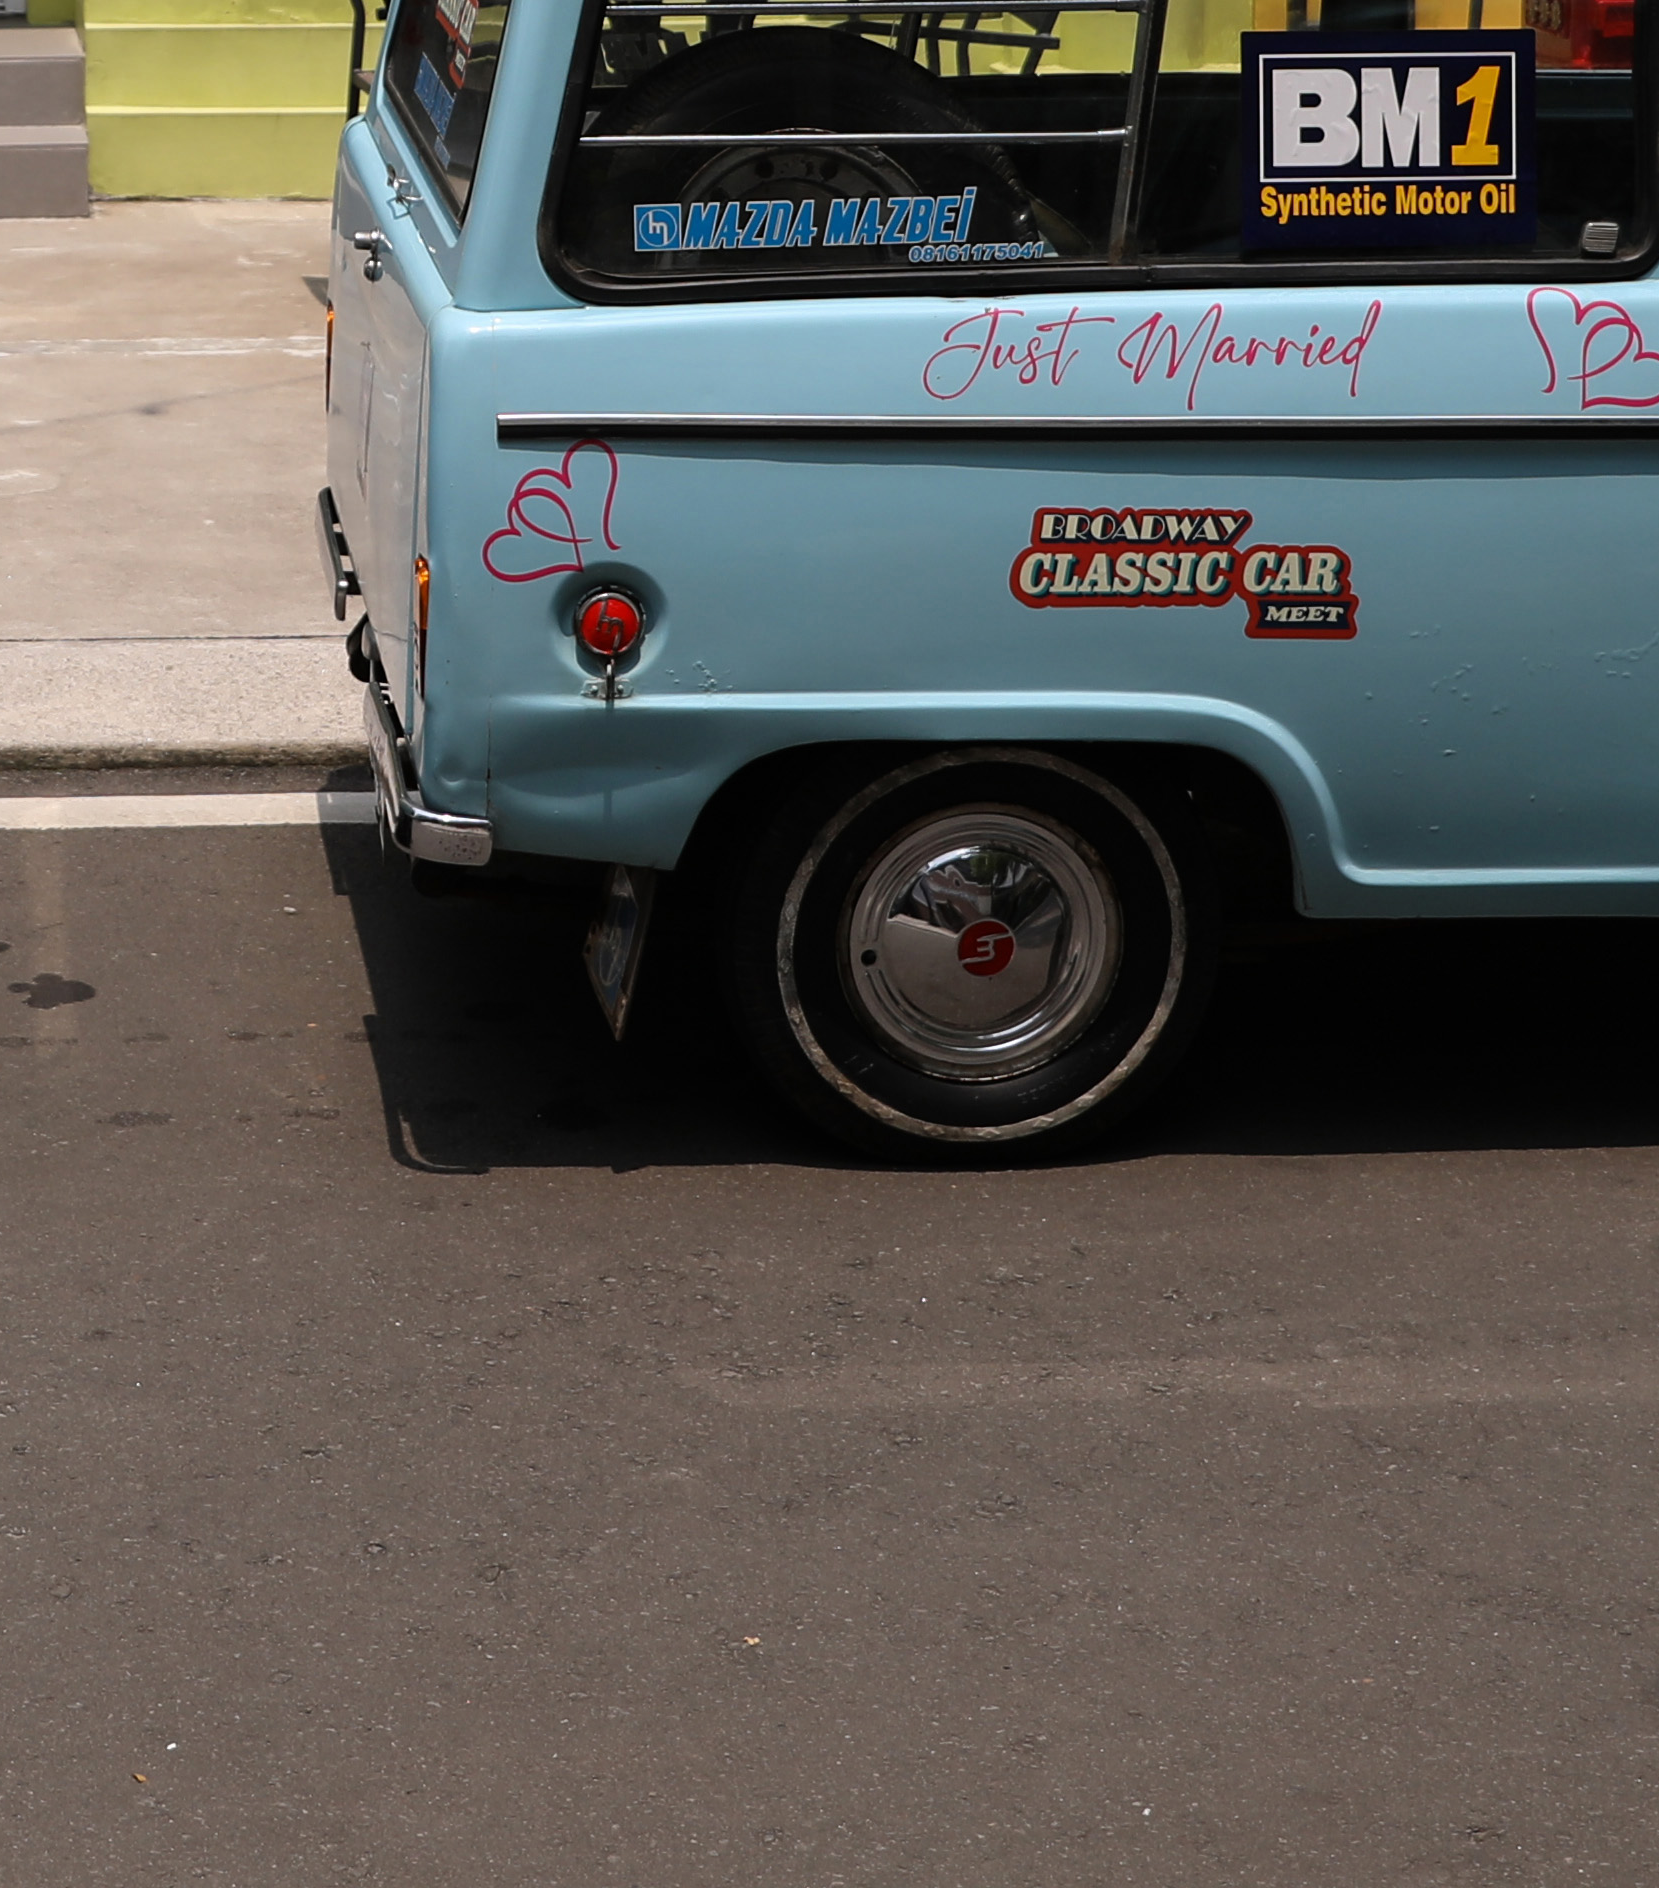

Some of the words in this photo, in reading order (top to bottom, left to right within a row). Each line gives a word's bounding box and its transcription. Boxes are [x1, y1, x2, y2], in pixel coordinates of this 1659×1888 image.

[1272, 65, 1501, 168] BM1
[681, 199, 817, 250] MAZDA
[1261, 185, 1387, 224] Synthetic
[1395, 184, 1471, 215] Motor
[1480, 183, 1516, 215] Oil
[908, 241, 1044, 263] 08161175041
[922, 305, 1115, 401] Just
[1117, 298, 1383, 411] Married
[1040, 514, 1247, 544] BROADWAY
[1019, 551, 1231, 597] CLASSIC
[1243, 551, 1341, 595] CAR
[1265, 606, 1344, 623] MEET
